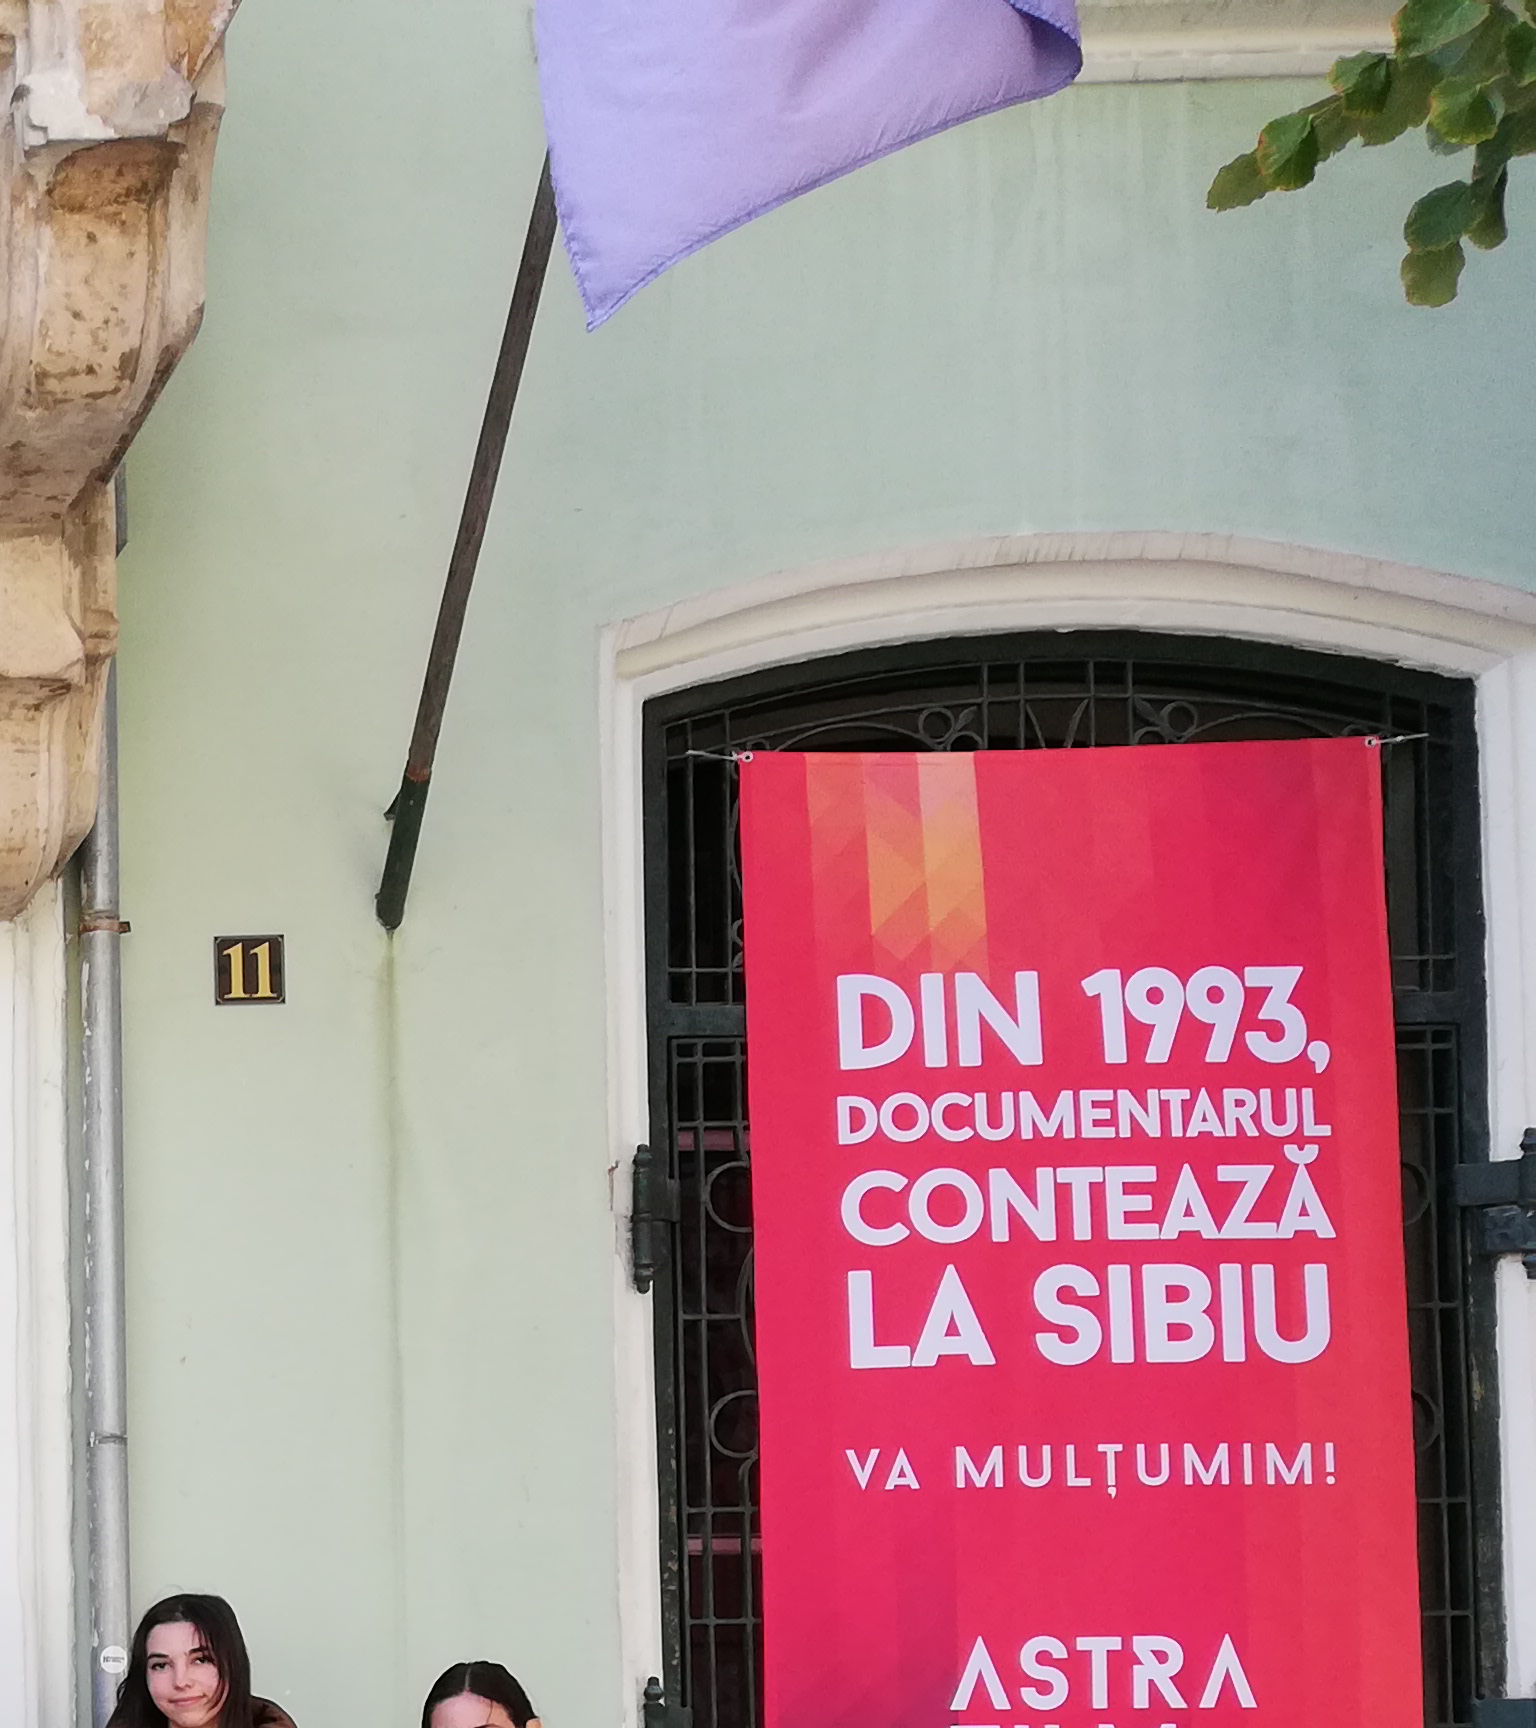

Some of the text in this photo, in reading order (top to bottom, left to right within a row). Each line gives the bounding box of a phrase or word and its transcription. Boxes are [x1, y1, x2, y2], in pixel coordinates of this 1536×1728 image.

[223, 942, 277, 998] 11
[837, 966, 1330, 1073] DIN 1993,
[837, 1088, 1331, 1145] DOCUMENTARUL
[839, 1143, 1336, 1246] CONTEAZĂ
[848, 1264, 1330, 1369] LA SIBIU
[846, 1448, 920, 1489] VA
[950, 1634, 1257, 1710] ASTRA
